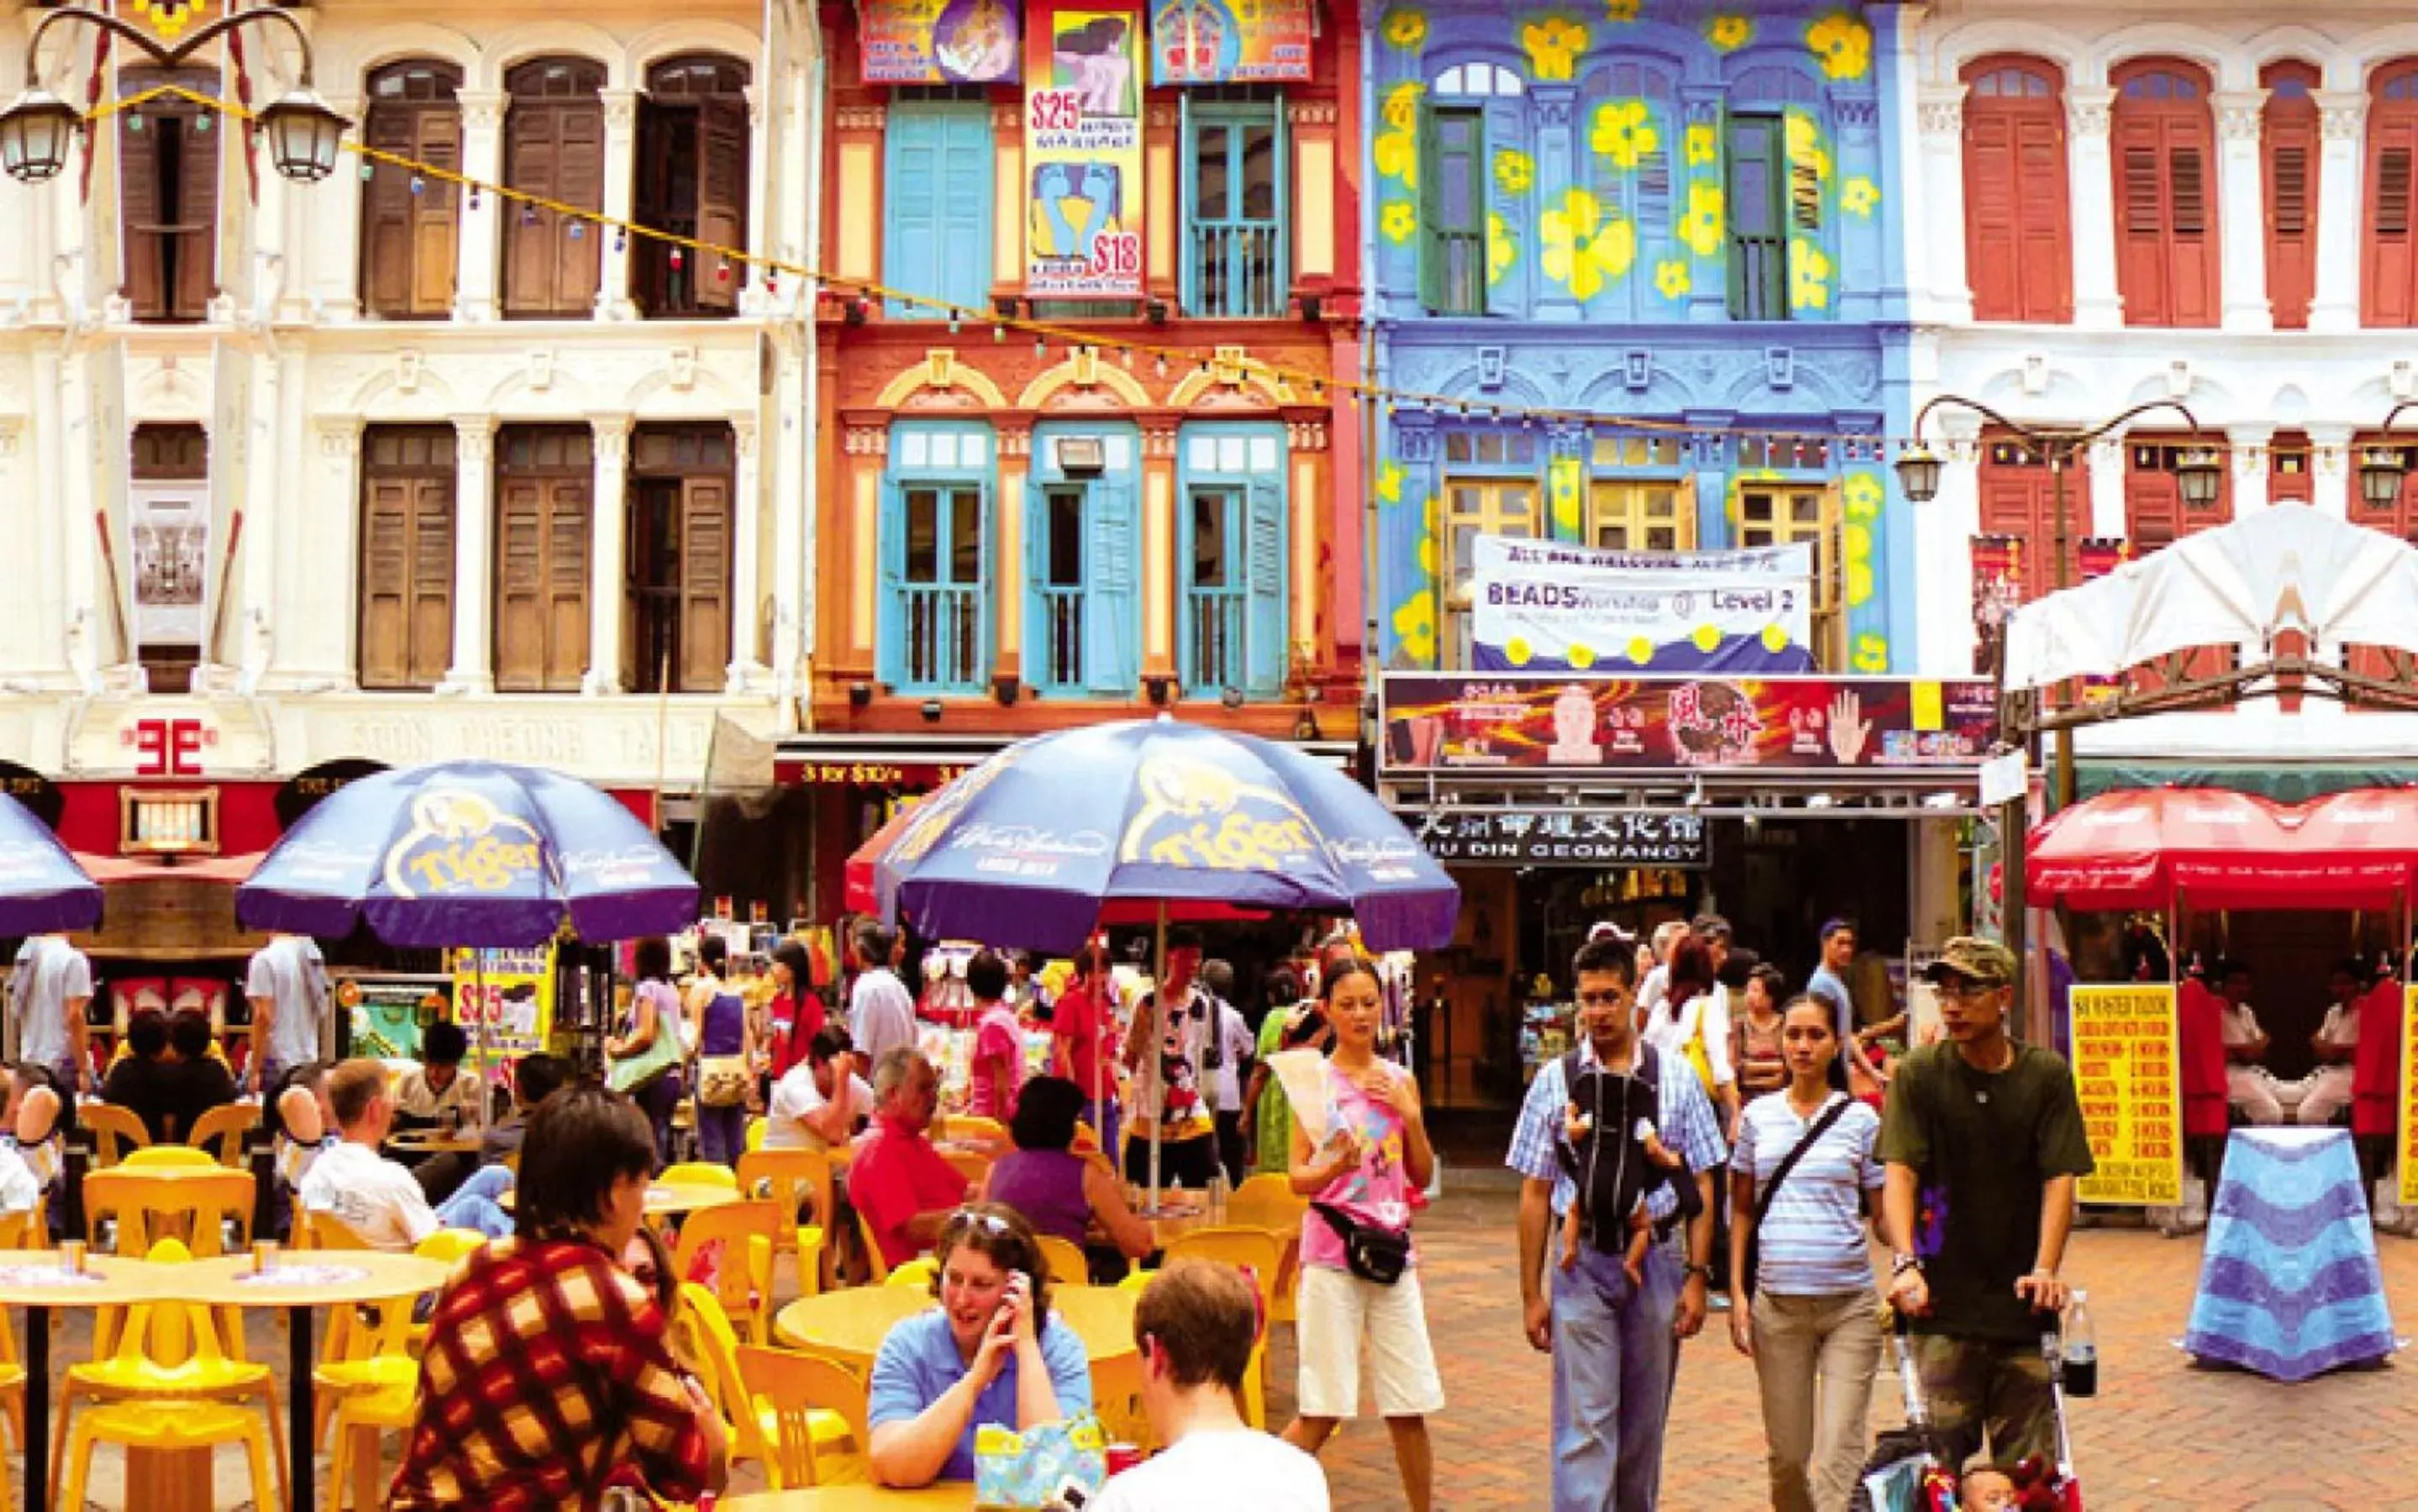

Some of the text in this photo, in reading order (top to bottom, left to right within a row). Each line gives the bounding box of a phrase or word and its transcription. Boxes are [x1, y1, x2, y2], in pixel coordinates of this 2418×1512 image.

[1094, 234, 1138, 274] $18
[1712, 589, 1773, 612] Level
[1782, 589, 1795, 612] 2
[1149, 812, 1316, 871] Tiger
[1470, 842, 1518, 858] DIN
[1530, 843, 1702, 859] GEOMANCY
[410, 836, 540, 890] Tiger
